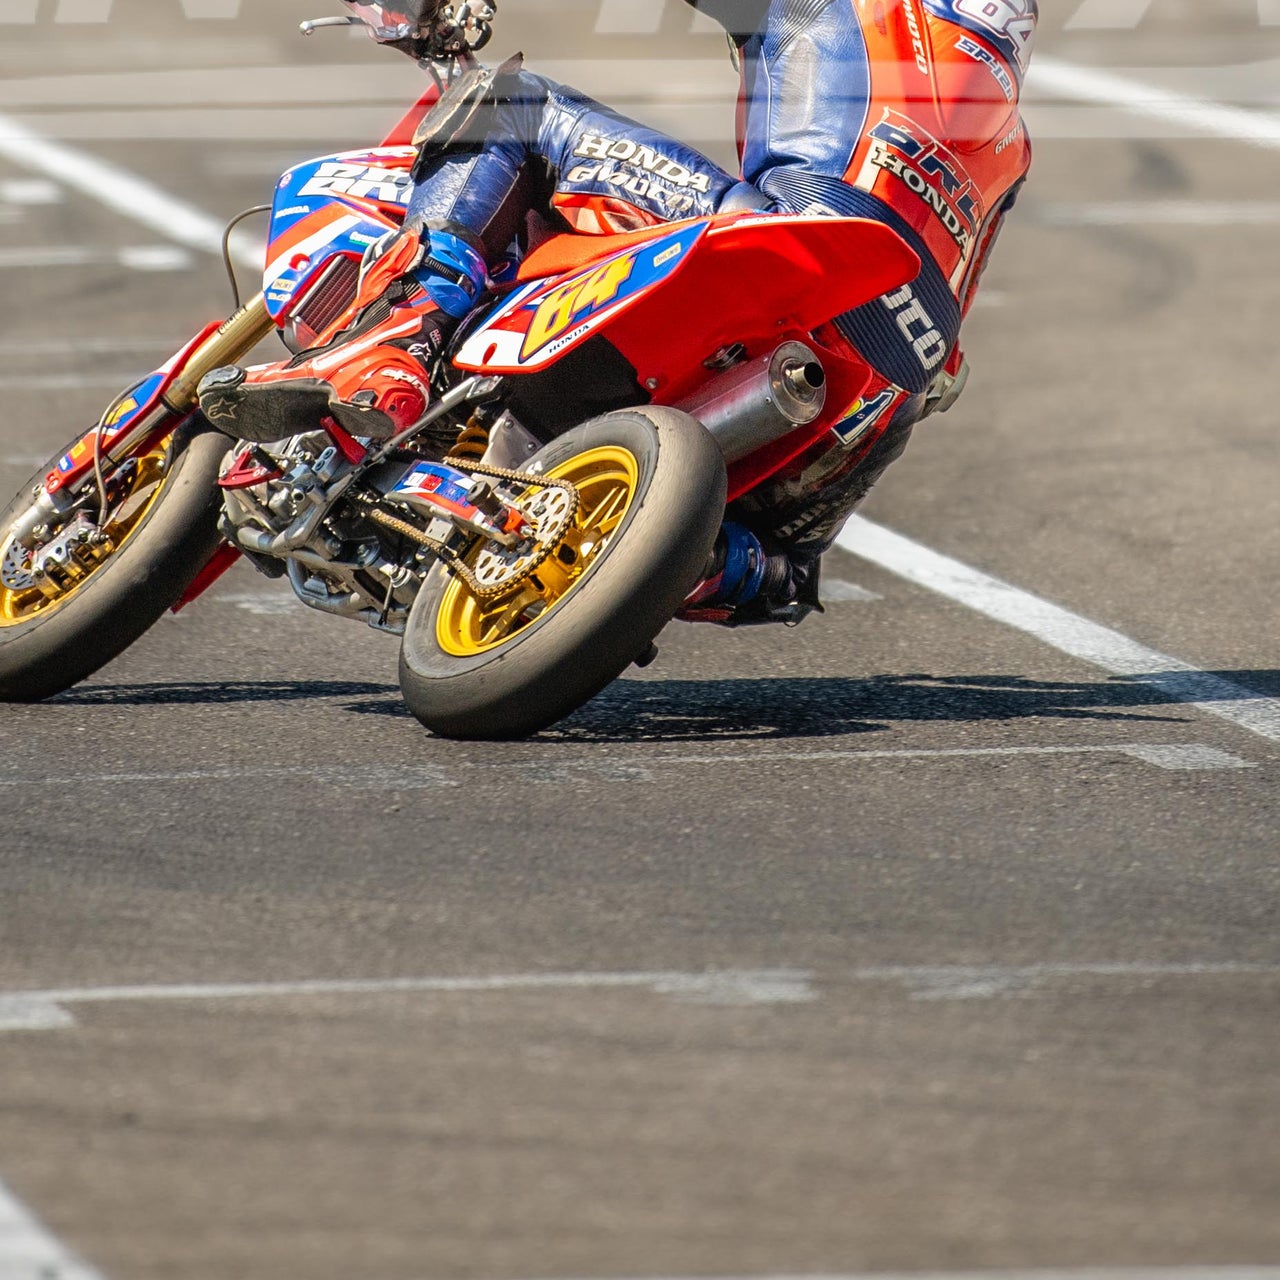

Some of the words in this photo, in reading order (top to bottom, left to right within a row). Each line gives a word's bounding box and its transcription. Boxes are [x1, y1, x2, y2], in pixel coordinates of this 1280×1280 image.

[573, 133, 711, 193] HONDA
[871, 146, 972, 260] HONDA
[520, 249, 637, 363] 64
[548, 324, 590, 353] HONDA
